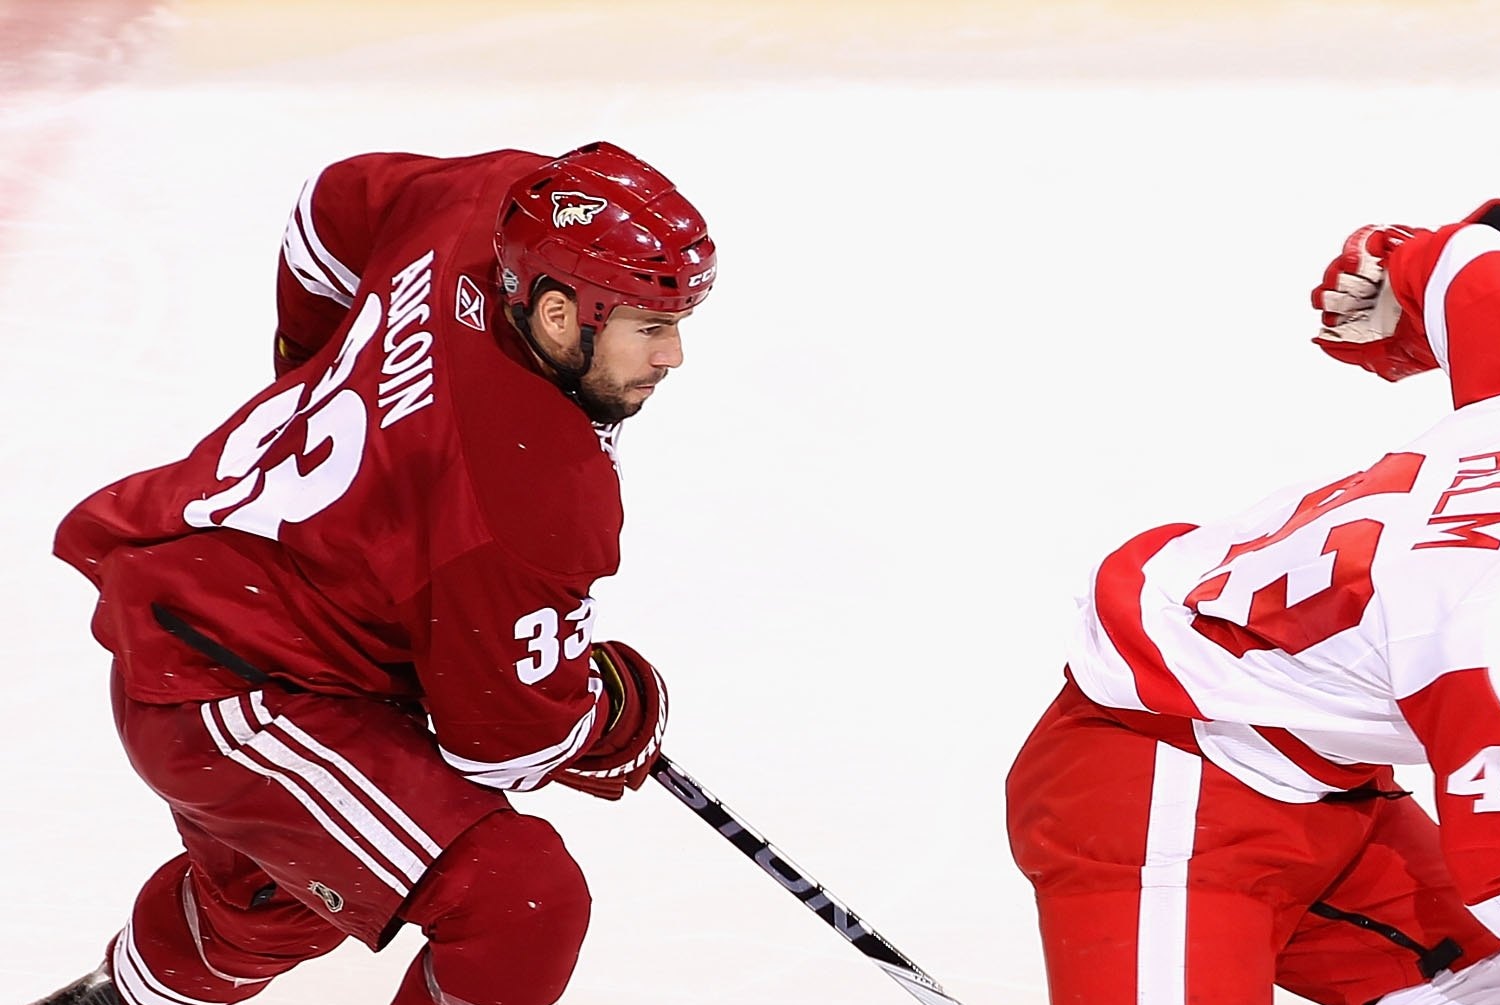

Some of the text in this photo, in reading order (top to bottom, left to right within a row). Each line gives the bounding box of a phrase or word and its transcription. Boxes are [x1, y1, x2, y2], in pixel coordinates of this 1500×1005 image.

[377, 249, 435, 430] AUCOIN
[513, 597, 593, 687] 33
[1183, 451, 1427, 659] 43
